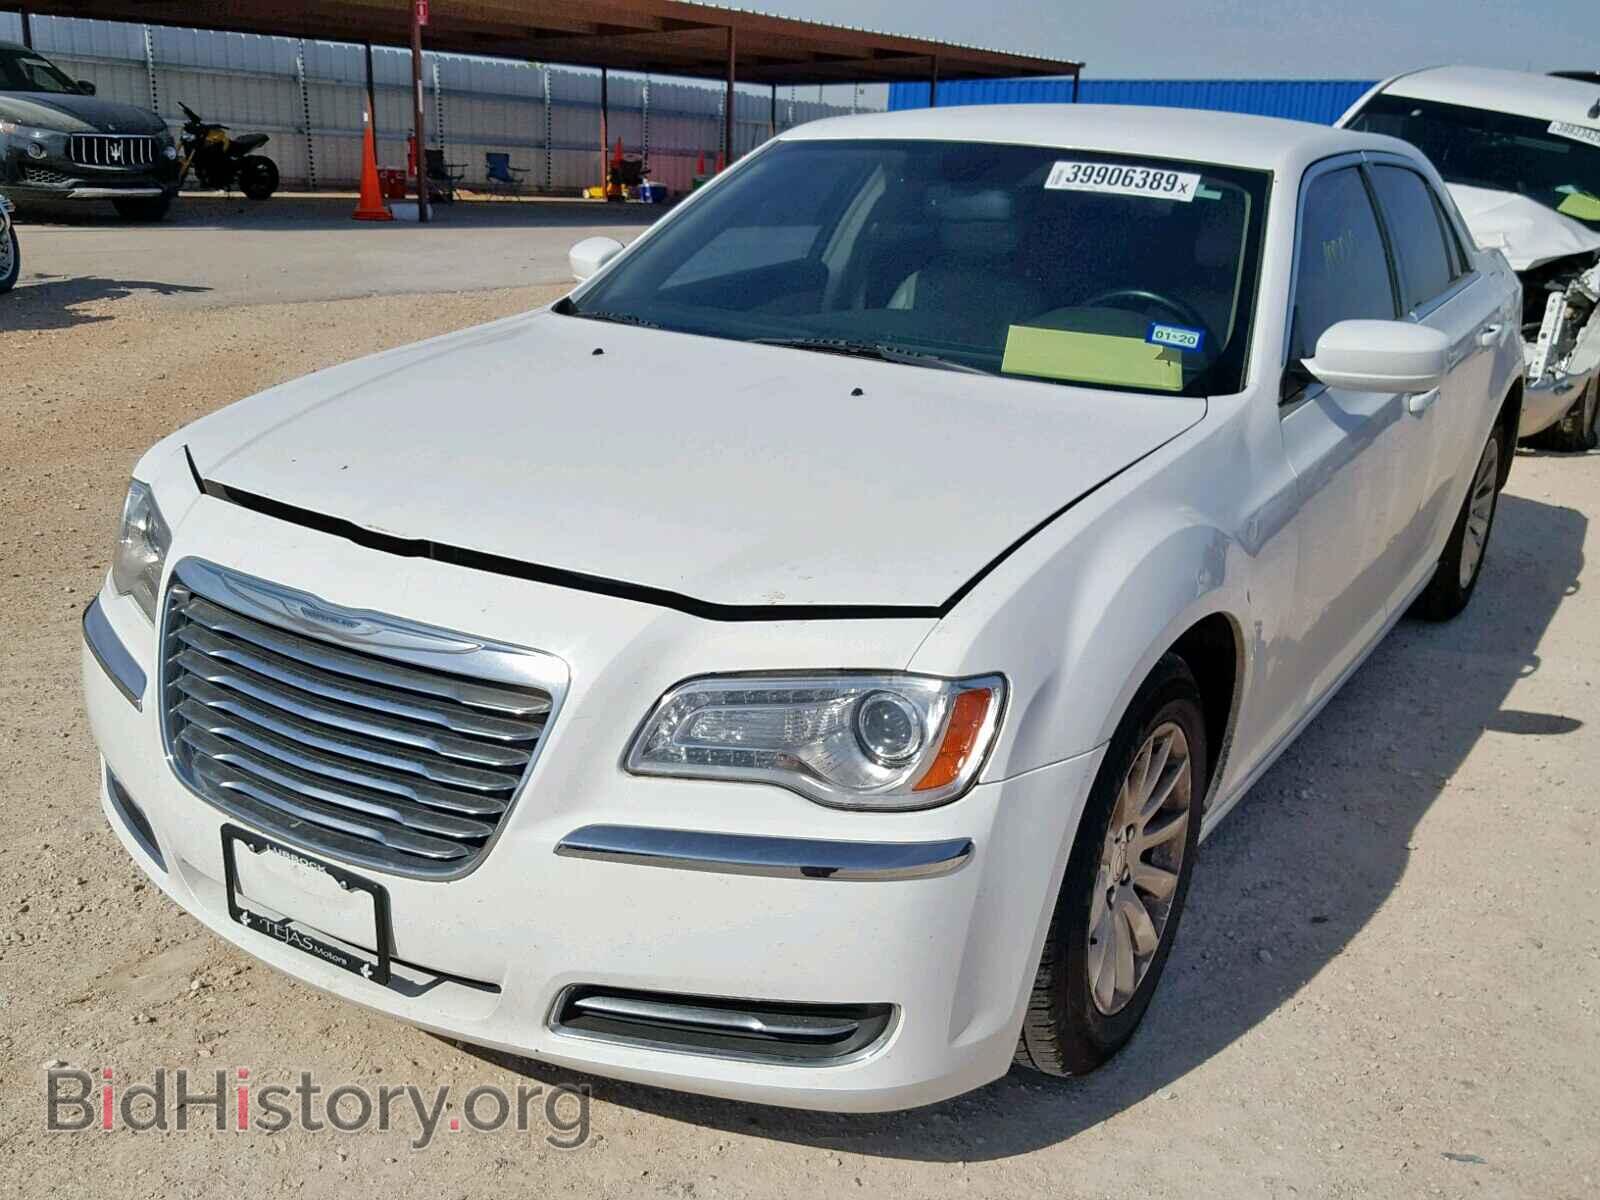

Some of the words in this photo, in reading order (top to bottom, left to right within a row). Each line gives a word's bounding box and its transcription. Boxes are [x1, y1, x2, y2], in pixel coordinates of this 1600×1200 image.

[1065, 164, 1178, 192] 39906389
[260, 918, 313, 950] TEJAS
[313, 945, 348, 965] Motors
